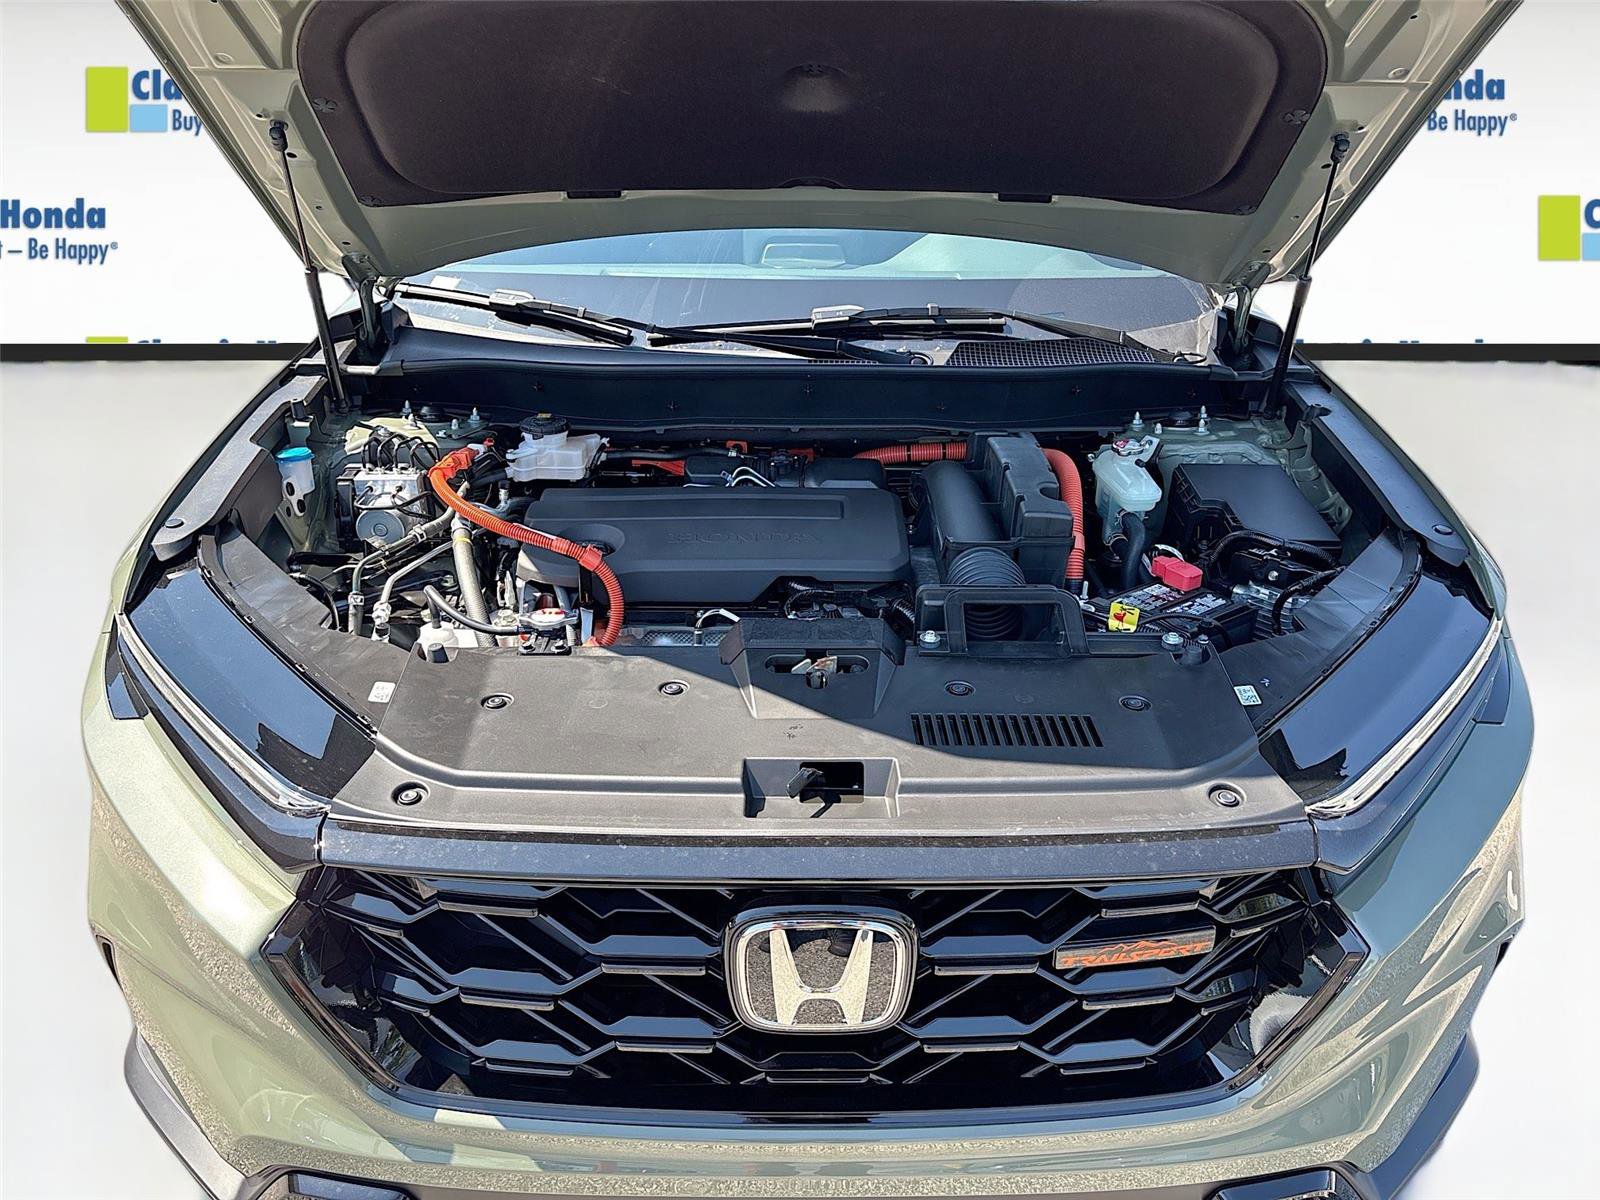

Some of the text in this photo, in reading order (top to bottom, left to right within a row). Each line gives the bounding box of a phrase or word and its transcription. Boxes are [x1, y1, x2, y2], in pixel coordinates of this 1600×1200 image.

[172, 109, 202, 136] Buy
[1427, 109, 1448, 131] Be
[0, 197, 106, 229] Honda
[28, 238, 48, 259] Be
